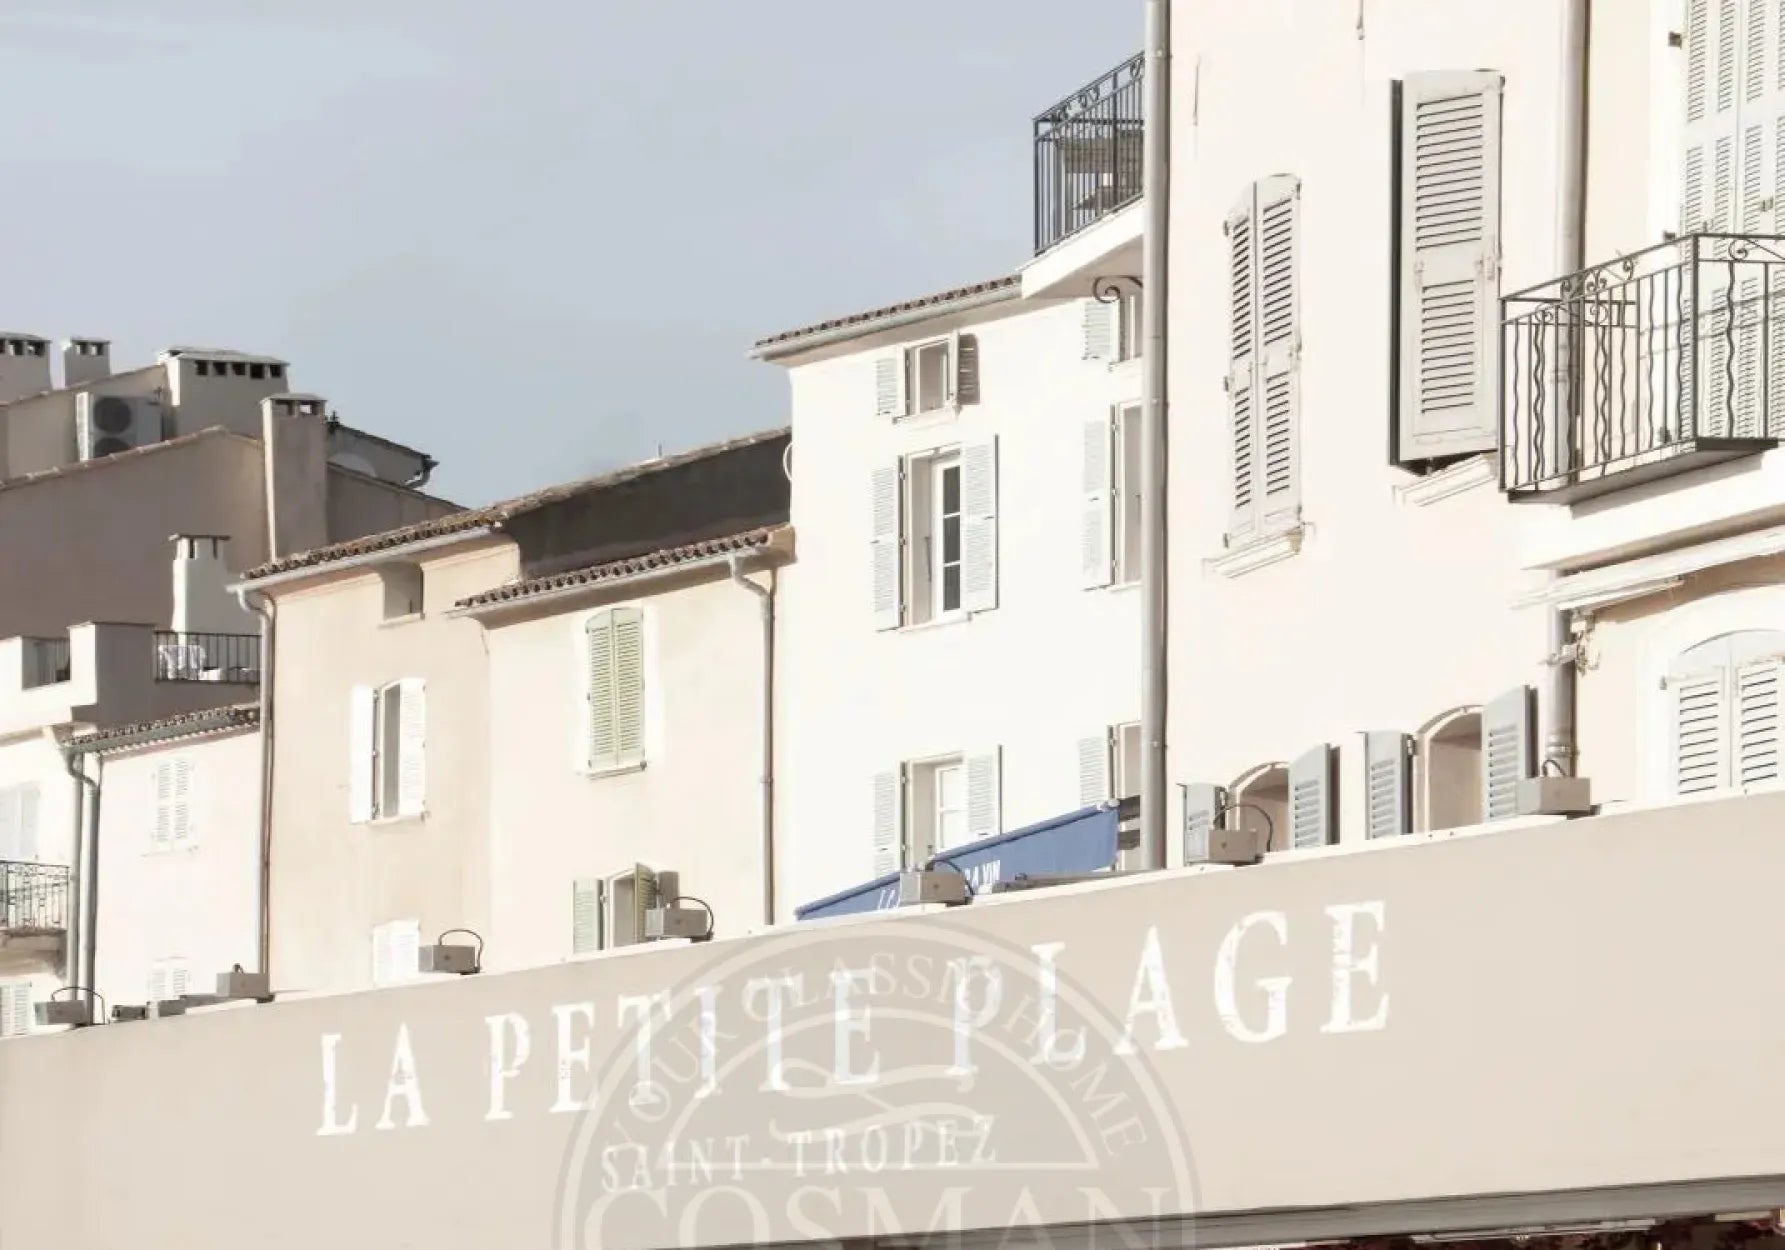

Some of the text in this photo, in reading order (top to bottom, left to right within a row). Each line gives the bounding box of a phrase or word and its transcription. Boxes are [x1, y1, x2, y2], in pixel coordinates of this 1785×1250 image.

[315, 900, 1391, 1137] LA PETITE PLAGE
